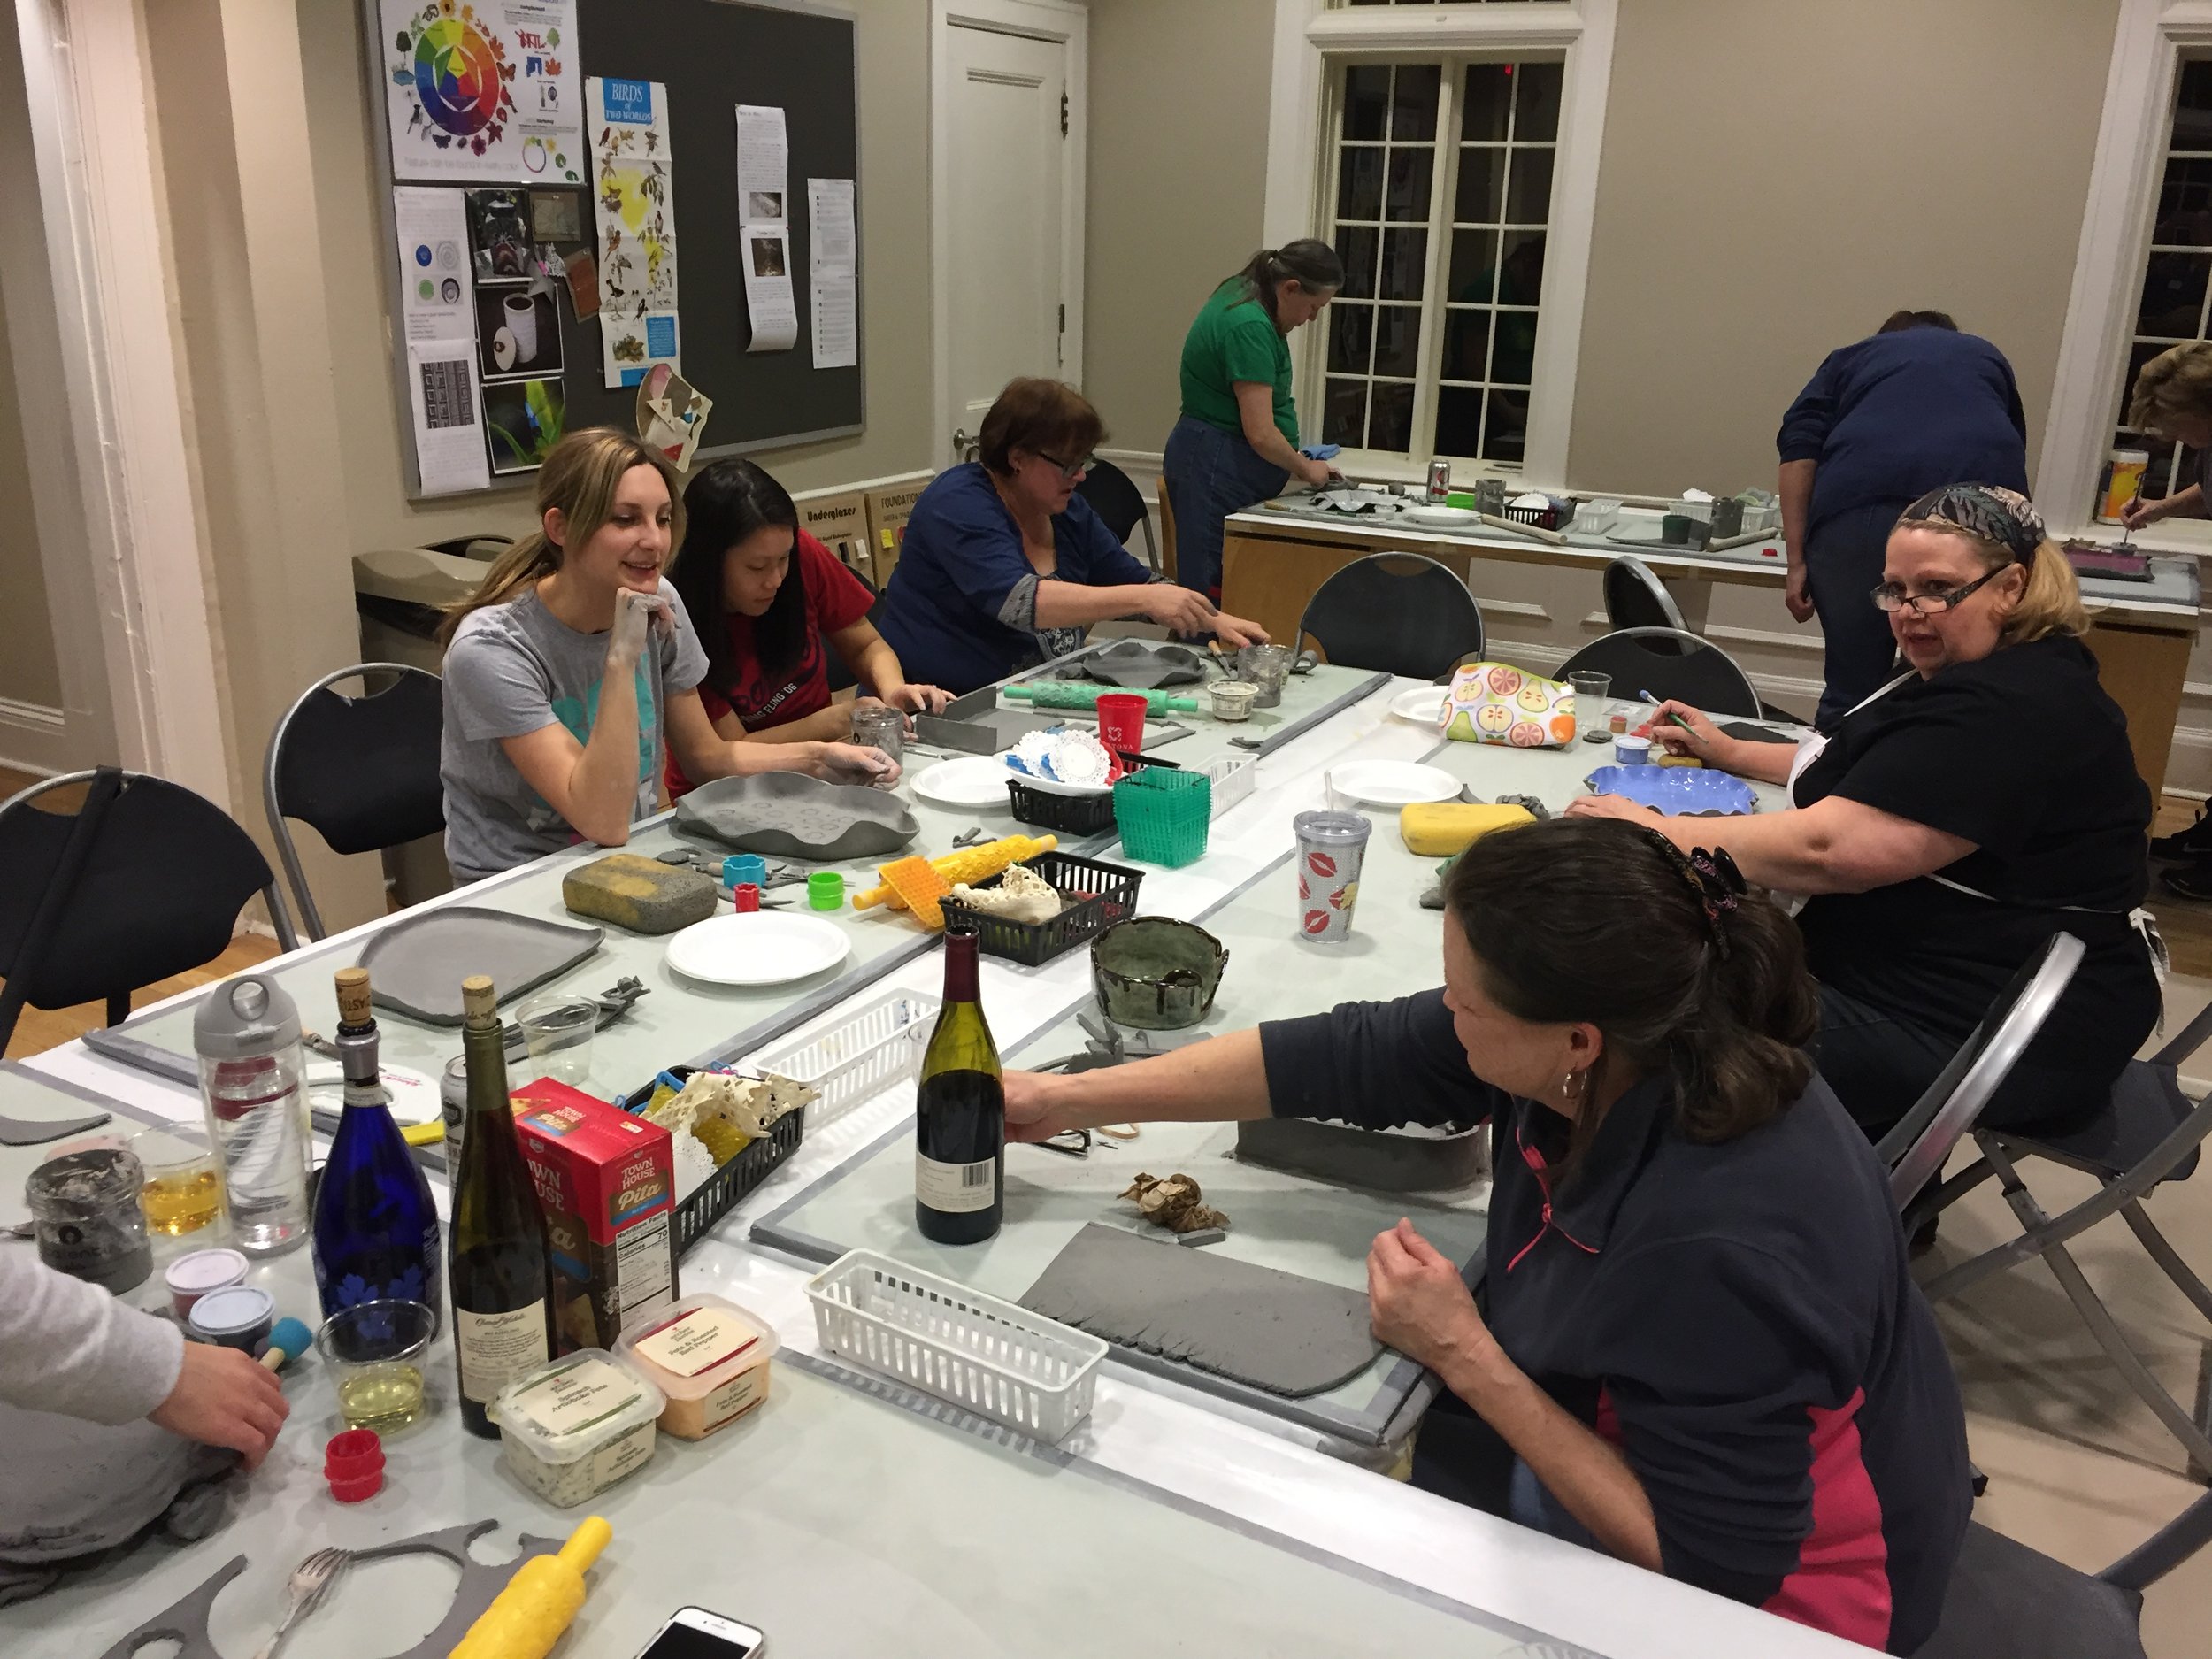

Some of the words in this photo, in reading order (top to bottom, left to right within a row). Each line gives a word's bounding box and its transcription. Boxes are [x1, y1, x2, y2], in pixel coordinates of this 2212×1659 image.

[612, 83, 643, 102] BIRDS
[606, 110, 621, 119] TWO
[623, 111, 651, 121] WORLDS
[625, 102, 631, 111] of
[807, 507, 856, 522] Underglazes
[763, 693, 786, 713] FLING
[780, 683, 797, 694] '06
[561, 1106, 586, 1118] TOWN
[535, 1113, 568, 1130] Pita
[621, 1156, 653, 1179] TOWN
[622, 1167, 655, 1190] HOUSE
[534, 1179, 564, 1211] USE
[618, 1183, 662, 1210] Pita
[617, 1222, 647, 1239] Nutrition
[649, 1212, 666, 1224] Facts
[657, 1230, 667, 1239] 70
[618, 1243, 645, 1259] Calories
